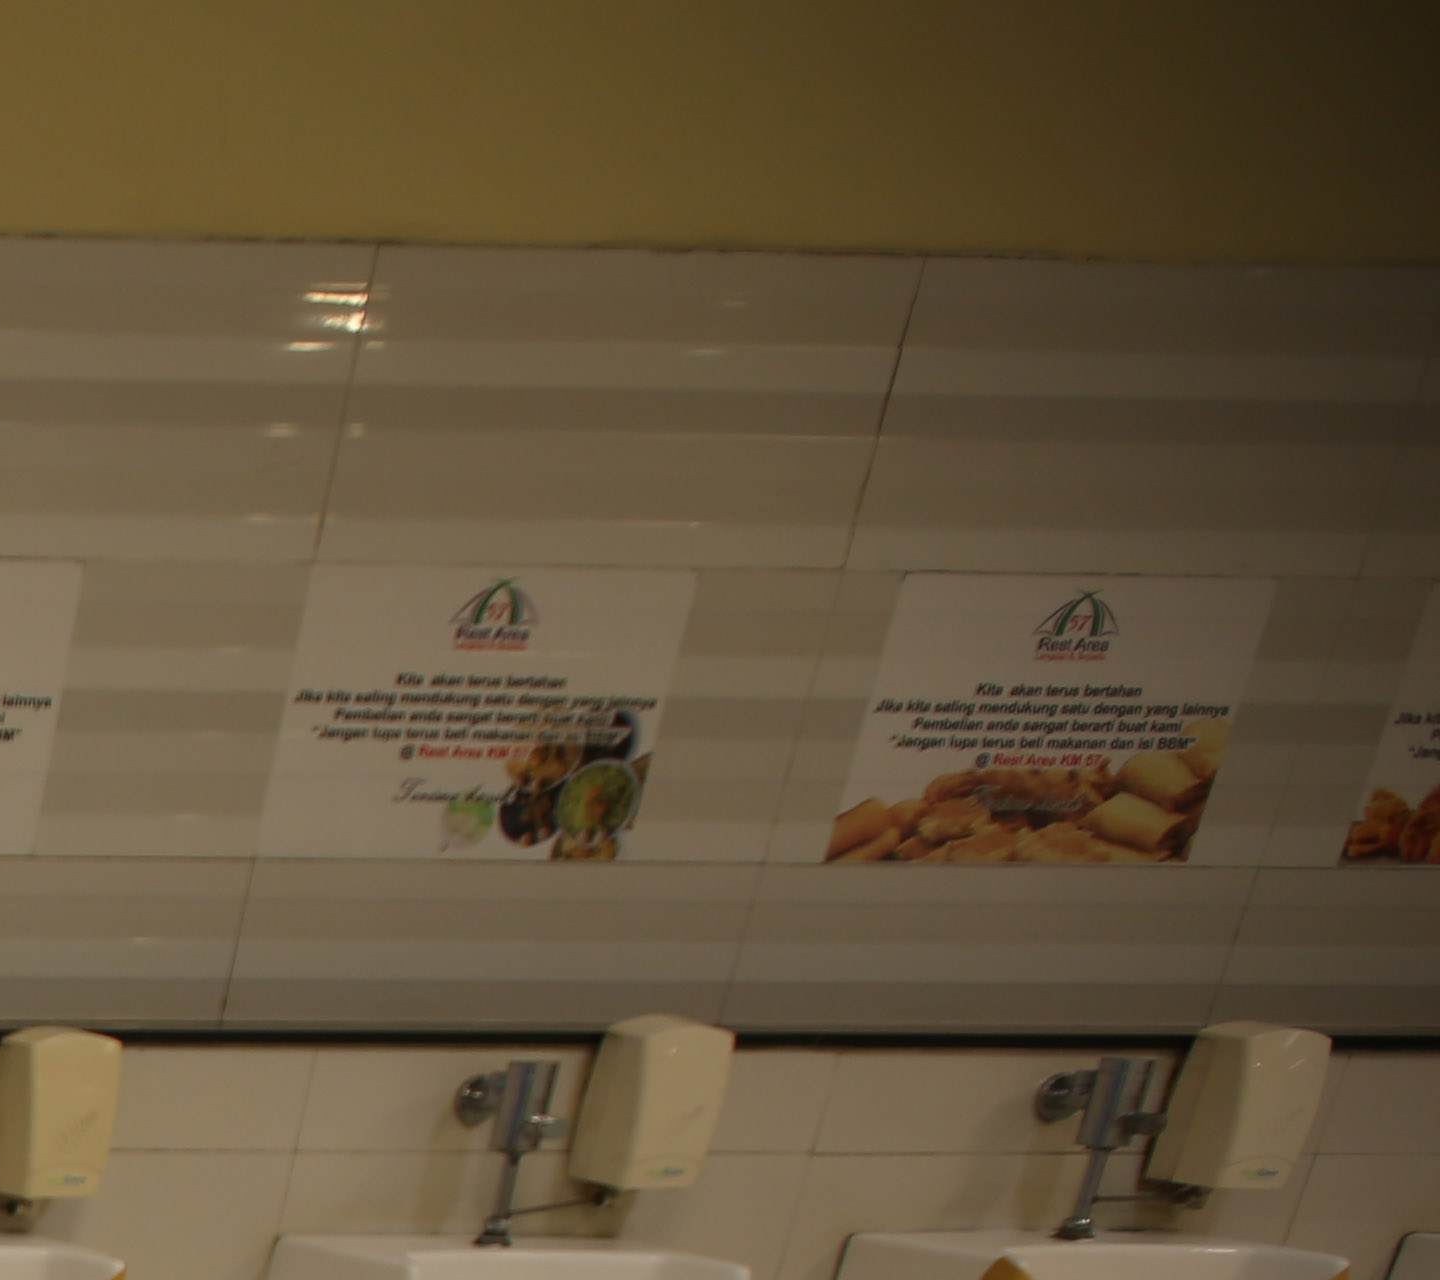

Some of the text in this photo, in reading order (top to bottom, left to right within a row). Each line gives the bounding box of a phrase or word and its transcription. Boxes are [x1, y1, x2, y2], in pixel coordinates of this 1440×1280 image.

[1038, 637, 1110, 651] Rest Area
[976, 682, 1143, 696] Kita akan terus bertahan
[874, 700, 1229, 718] Jika kita saling mendukung satu dengan yang lainnya
[913, 717, 1183, 733] Pembelian anda sangat berarti buat kami
